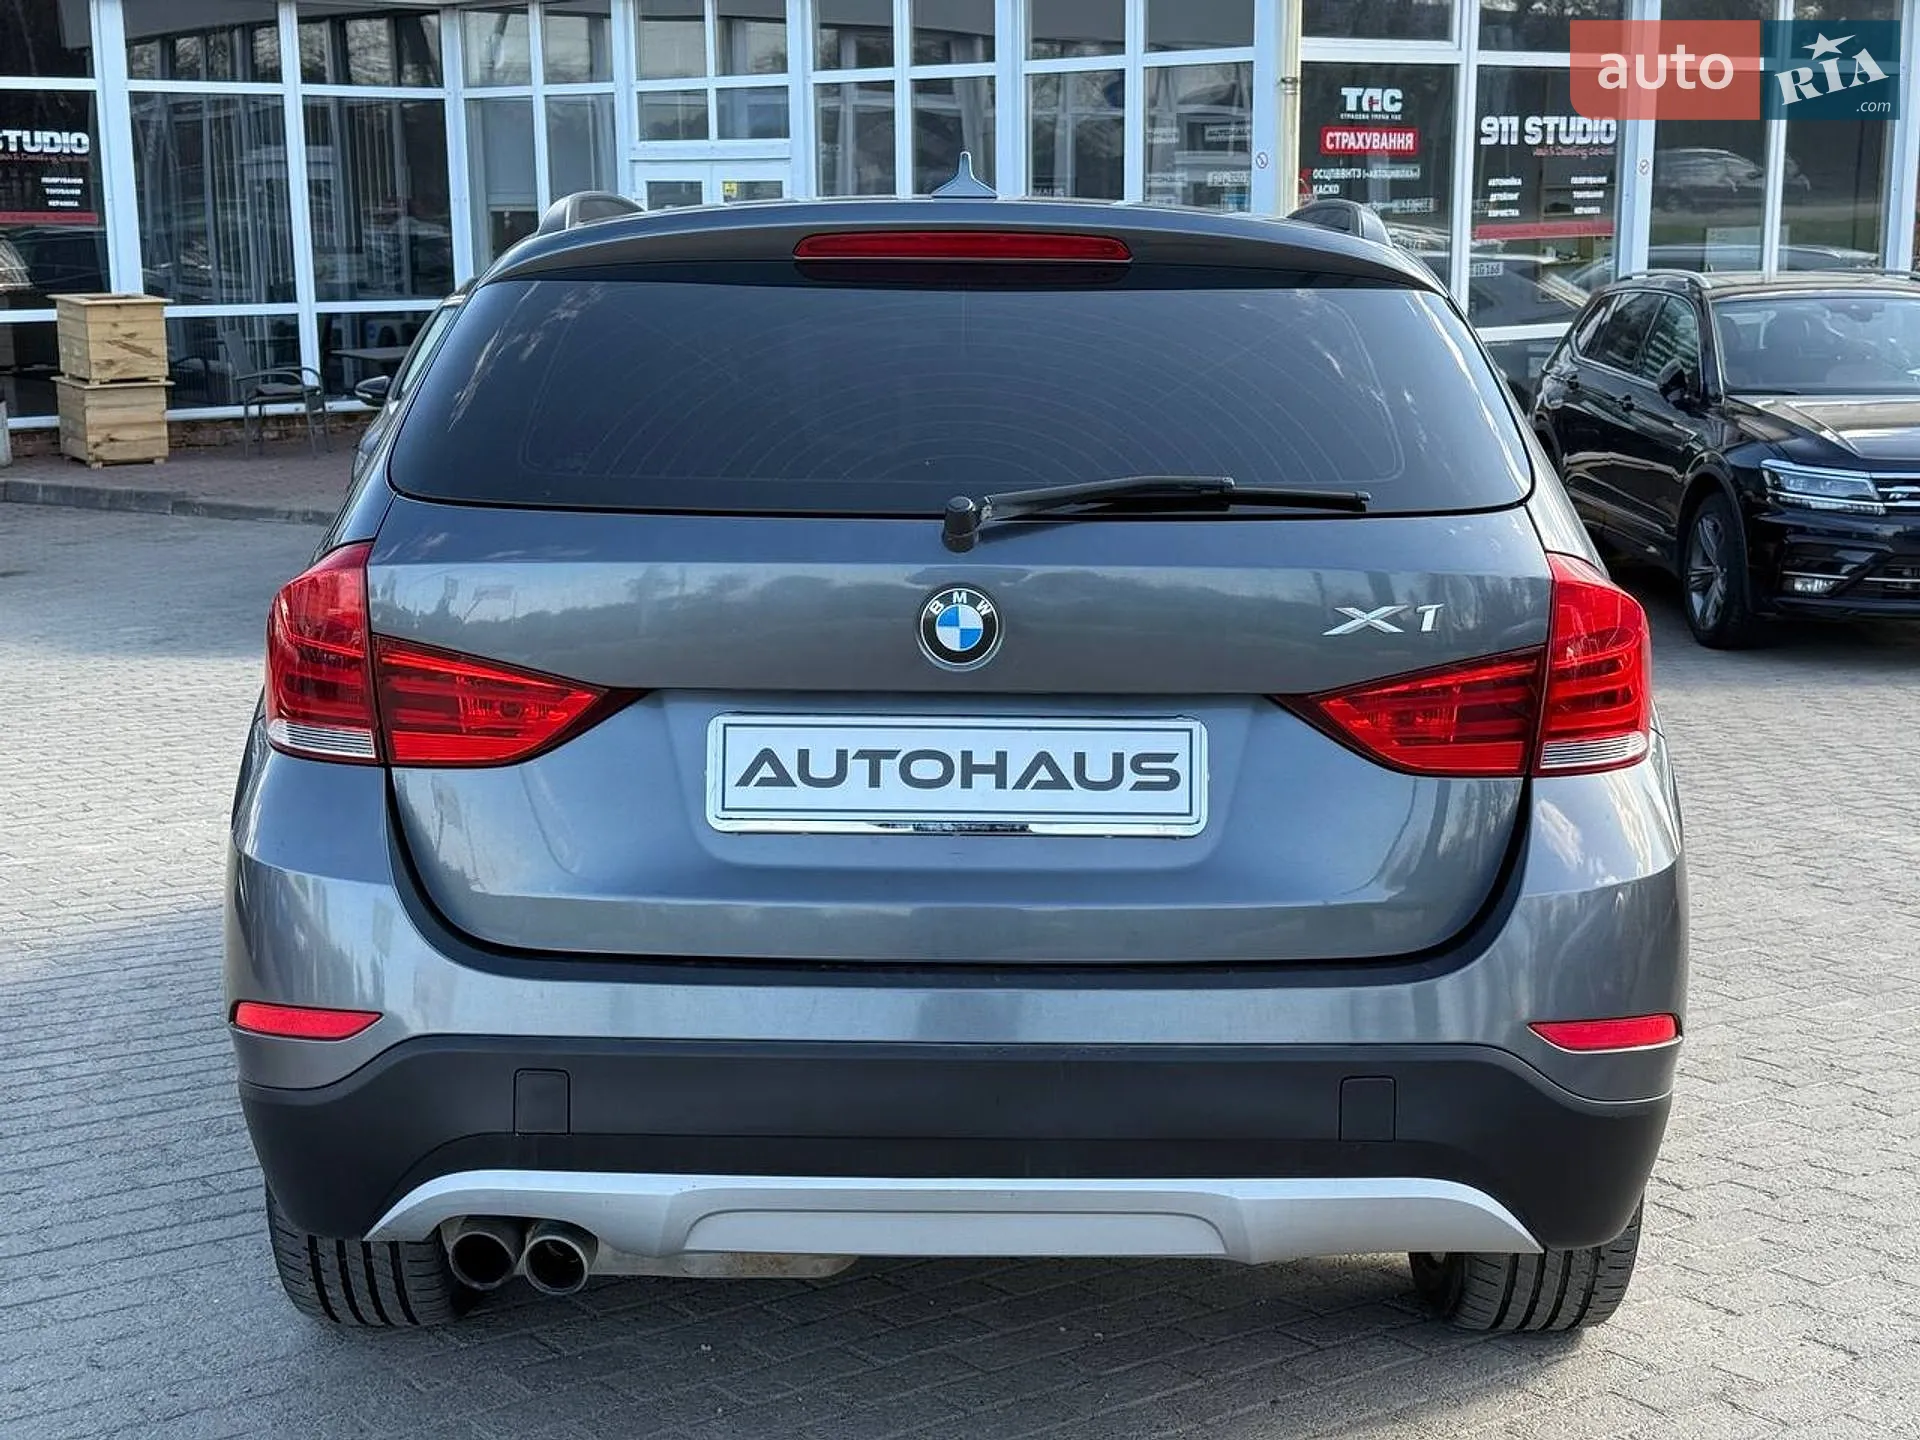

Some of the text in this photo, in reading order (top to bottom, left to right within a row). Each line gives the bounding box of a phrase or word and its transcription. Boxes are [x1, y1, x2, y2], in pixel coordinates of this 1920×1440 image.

[0, 129, 90, 154] TUDIO
[1326, 131, 1414, 150] СТРАХУВАННЯ
[1480, 116, 1617, 145] 911 STUDIO
[929, 591, 992, 616] BMW
[1321, 603, 1445, 636] X1
[734, 747, 1182, 792] AUTOHAUS
